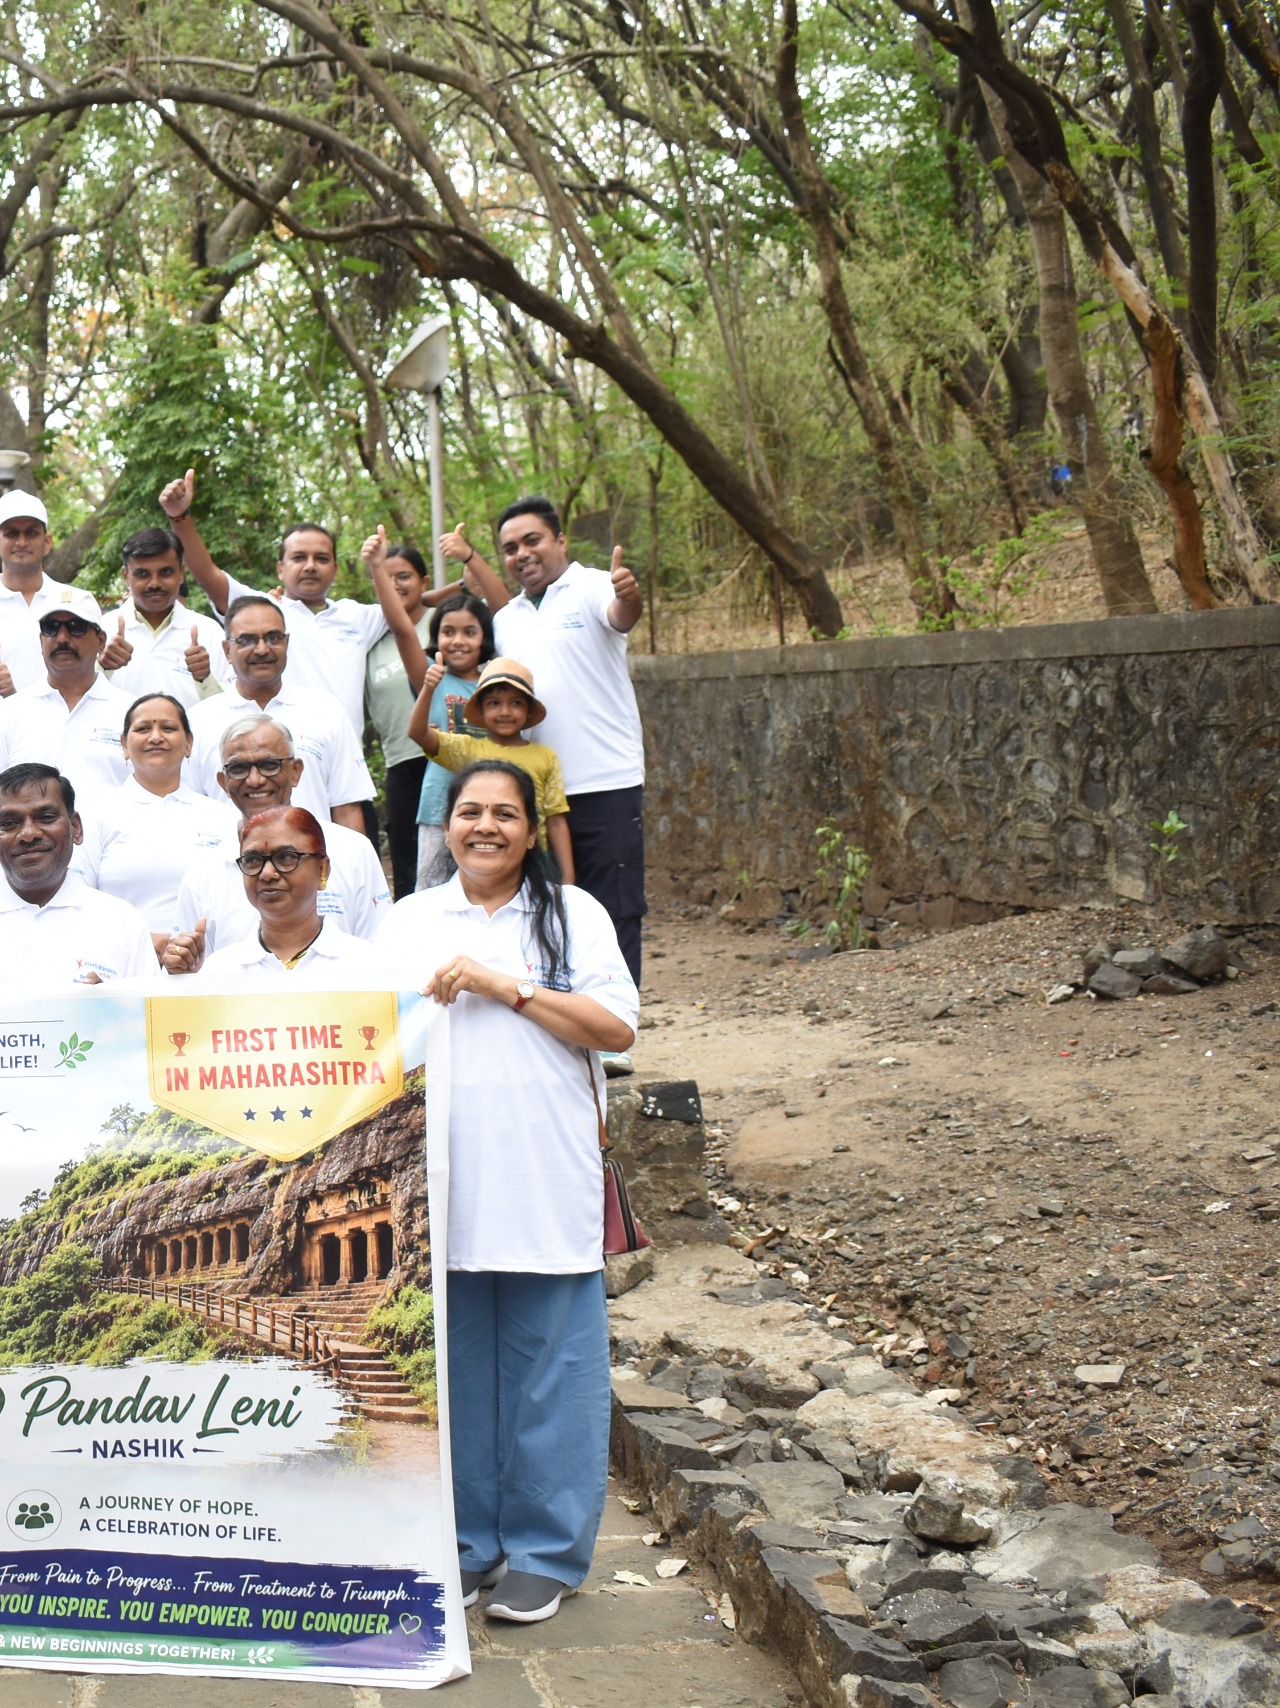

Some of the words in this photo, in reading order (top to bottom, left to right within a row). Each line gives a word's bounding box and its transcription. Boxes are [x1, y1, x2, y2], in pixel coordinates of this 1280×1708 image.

[212, 1028, 277, 1053] FIRST
[286, 1025, 343, 1050] TIME
[0, 1055, 38, 1068] LIFE!
[166, 1067, 190, 1091] IN
[199, 1061, 386, 1090] MAHARASHTRA
[20, 1375, 196, 1437] Pandav
[196, 1373, 302, 1439] Leni
[92, 1439, 185, 1460] NASHIK
[79, 1497, 91, 1510] A
[96, 1496, 174, 1511] JOURNEY
[179, 1499, 202, 1513] OF
[208, 1501, 258, 1517] HOPE.
[79, 1519, 91, 1531] A
[96, 1519, 210, 1538] CELEBRATION
[215, 1525, 237, 1539] OF
[243, 1527, 282, 1542] LIFE.
[0, 1564, 40, 1586] From
[45, 1563, 82, 1585] Pain
[86, 1568, 102, 1585] to
[107, 1566, 186, 1596] Progress...
[193, 1571, 235, 1594] From
[239, 1574, 316, 1597] Treatment
[320, 1583, 336, 1599] to
[341, 1580, 420, 1609] Triumph...
[0, 1594, 34, 1614] YOU
[38, 1595, 111, 1619] INSPIRE.
[120, 1600, 154, 1622] YOU
[158, 1603, 253, 1628] EMPOWER.
[261, 1608, 297, 1630] YOU
[302, 1611, 393, 1635] CONQUER.
[10, 1635, 45, 1650] NEW
[49, 1638, 143, 1655] BEGINNINGS
[148, 1643, 236, 1660] TOGETHER!
